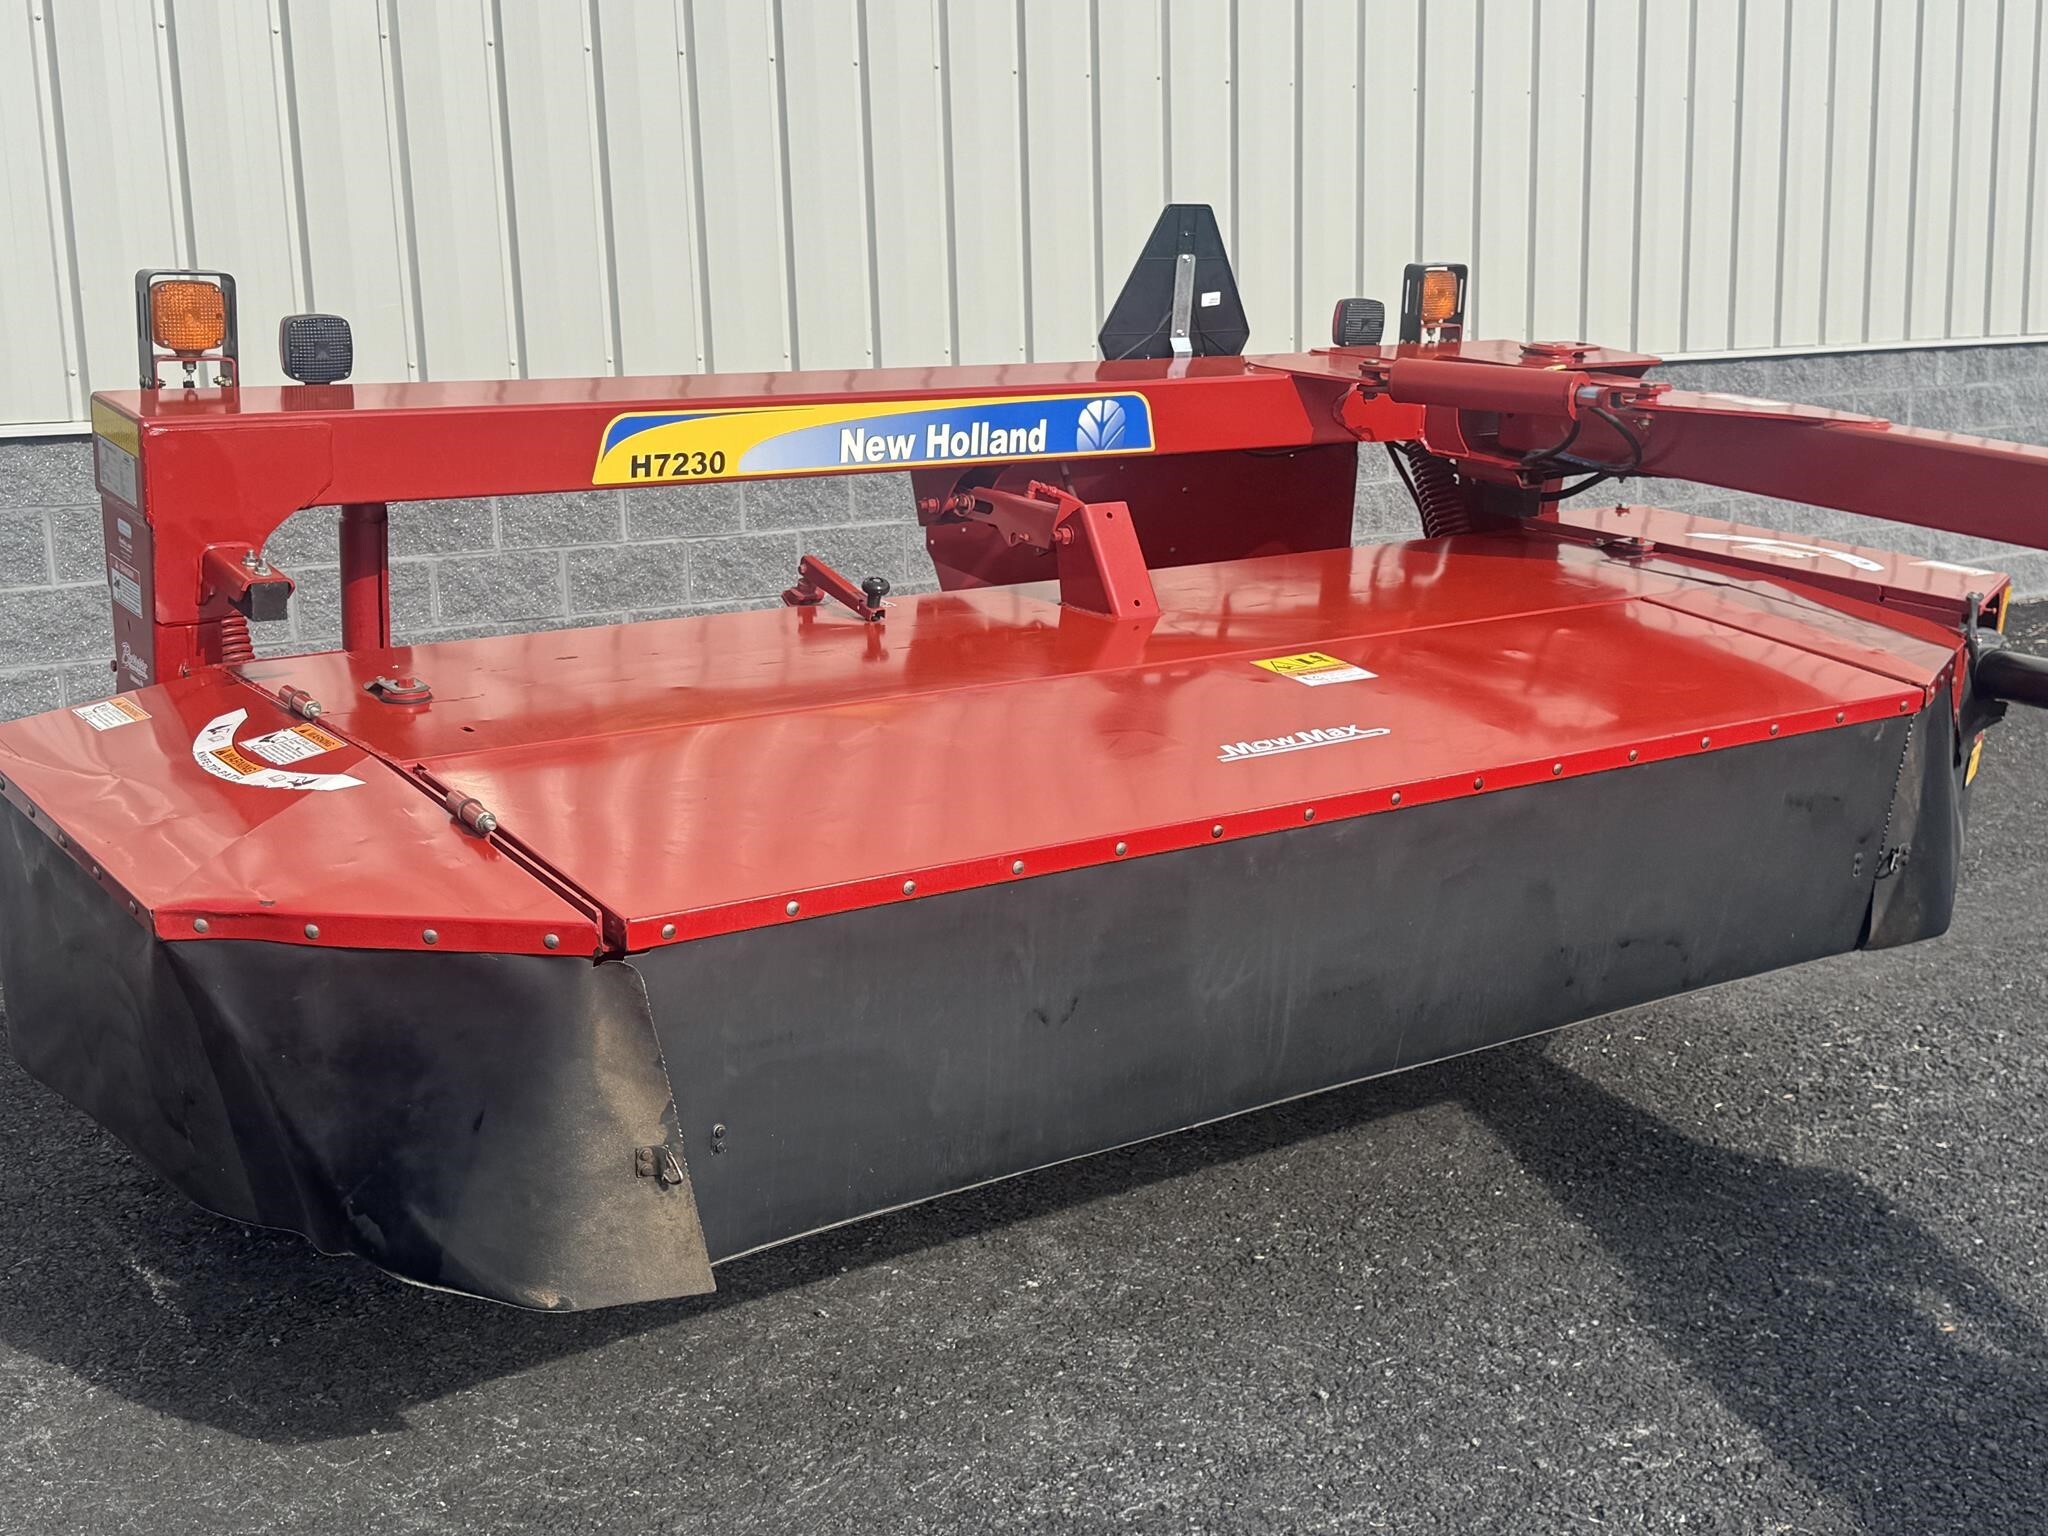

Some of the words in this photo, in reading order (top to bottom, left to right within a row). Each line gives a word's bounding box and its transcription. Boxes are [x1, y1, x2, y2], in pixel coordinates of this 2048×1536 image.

[839, 427, 915, 464] New
[926, 419, 1047, 459] Holland
[630, 450, 725, 480] H7230
[306, 731, 335, 748] WARNING
[1219, 734, 1296, 757] Mow
[1295, 724, 1363, 745] Max
[222, 748, 257, 775] WARNING
